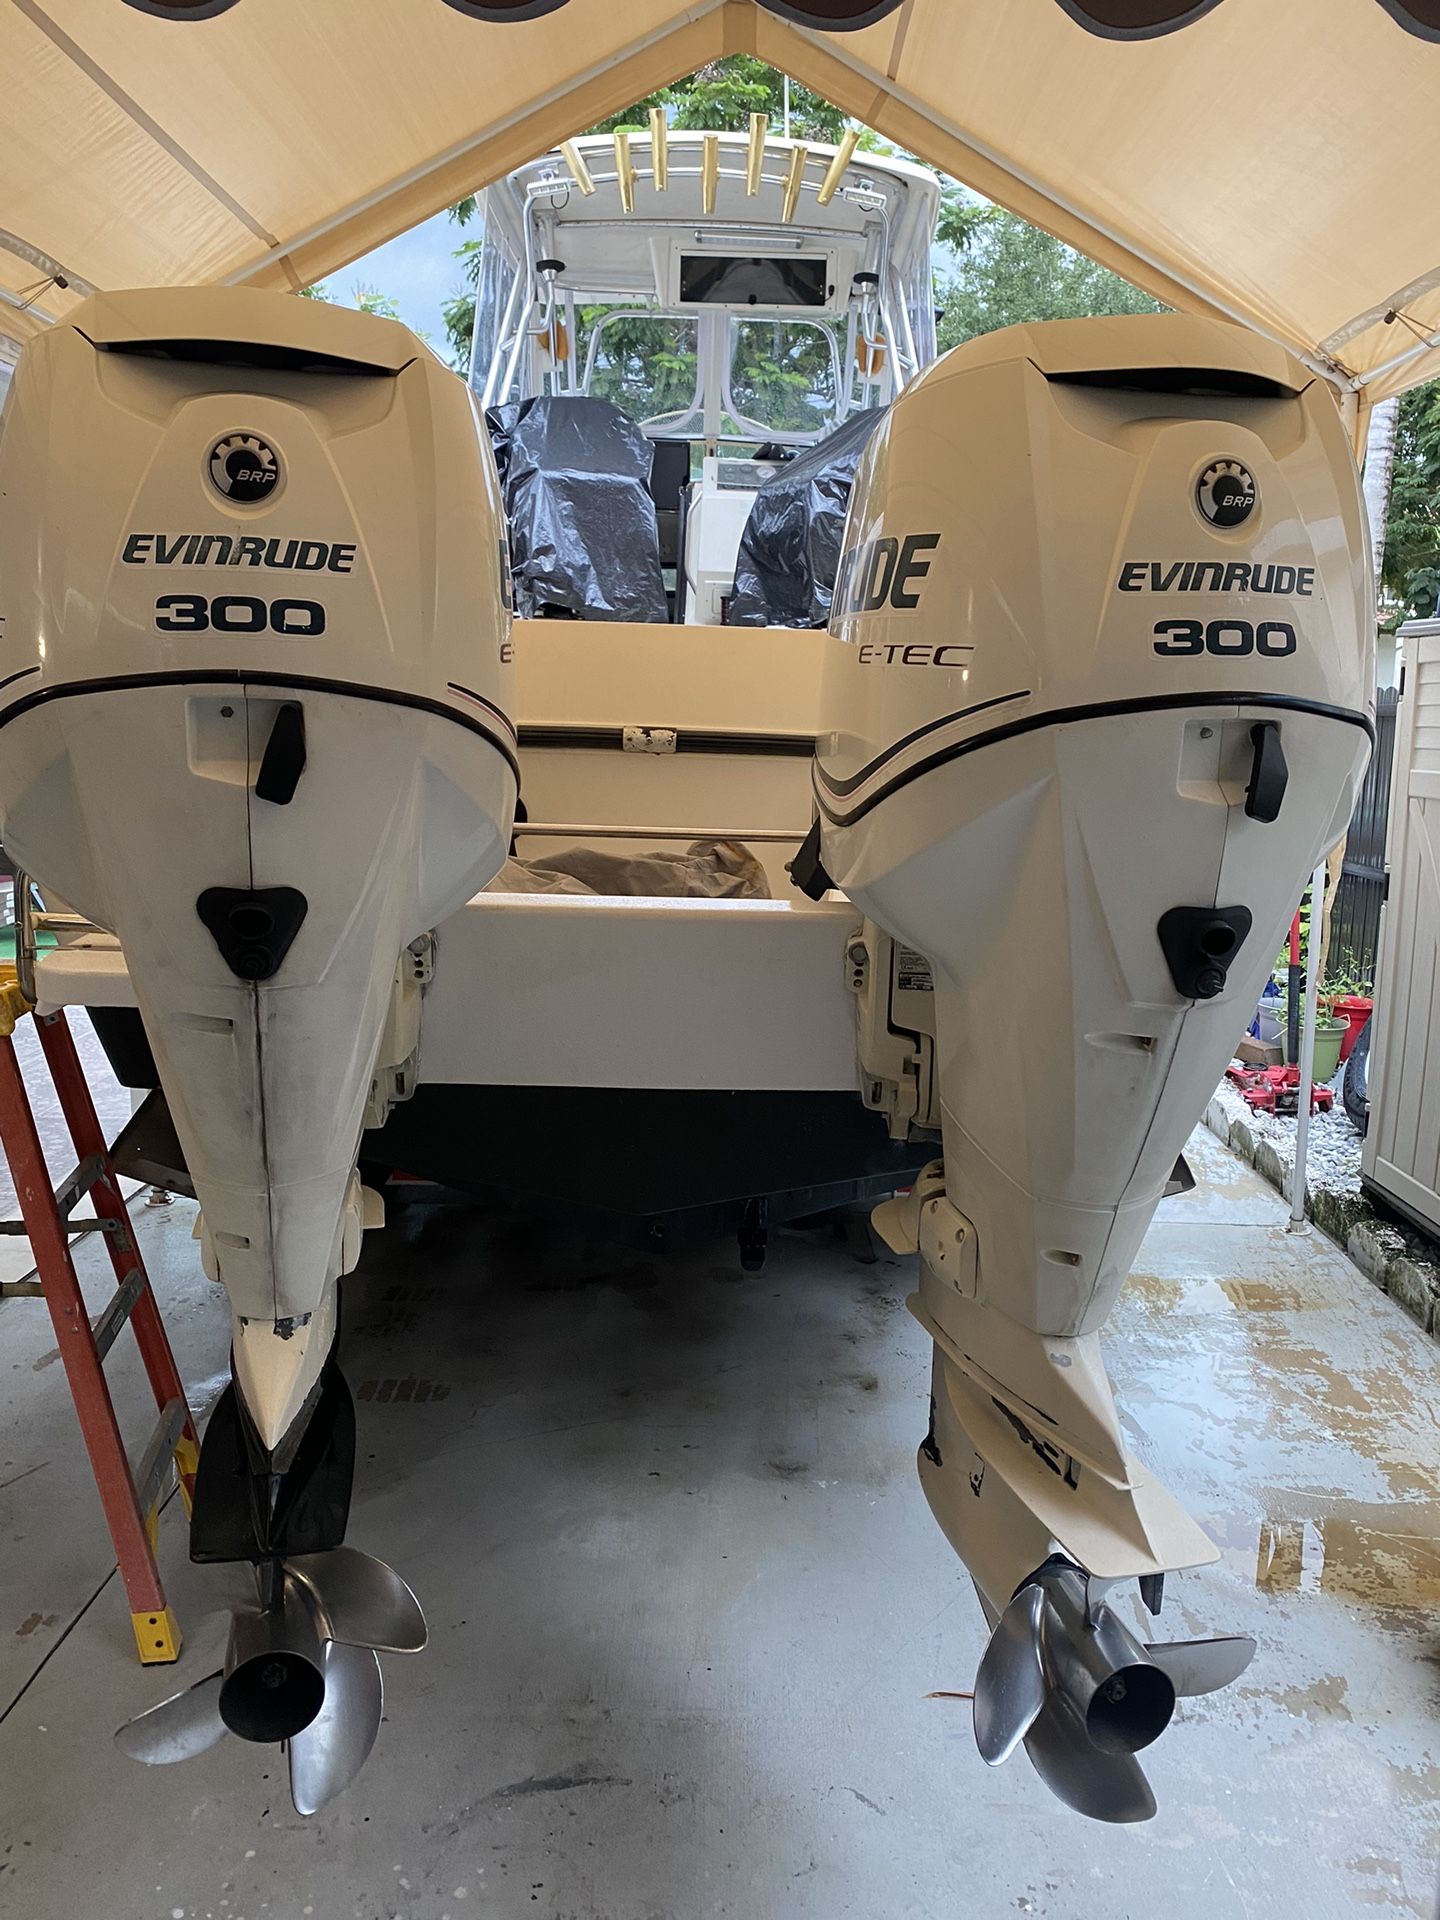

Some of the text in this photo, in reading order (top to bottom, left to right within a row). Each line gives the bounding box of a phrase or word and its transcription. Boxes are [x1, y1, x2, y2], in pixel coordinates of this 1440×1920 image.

[236, 468, 276, 484] BRP
[1222, 495, 1254, 508] BRP
[121, 533, 357, 574] EVINRUDE
[1117, 562, 1315, 596] EVINRUDE
[155, 594, 326, 636] 300
[1153, 619, 1297, 657] 300
[858, 644, 975, 667] E-TEC
